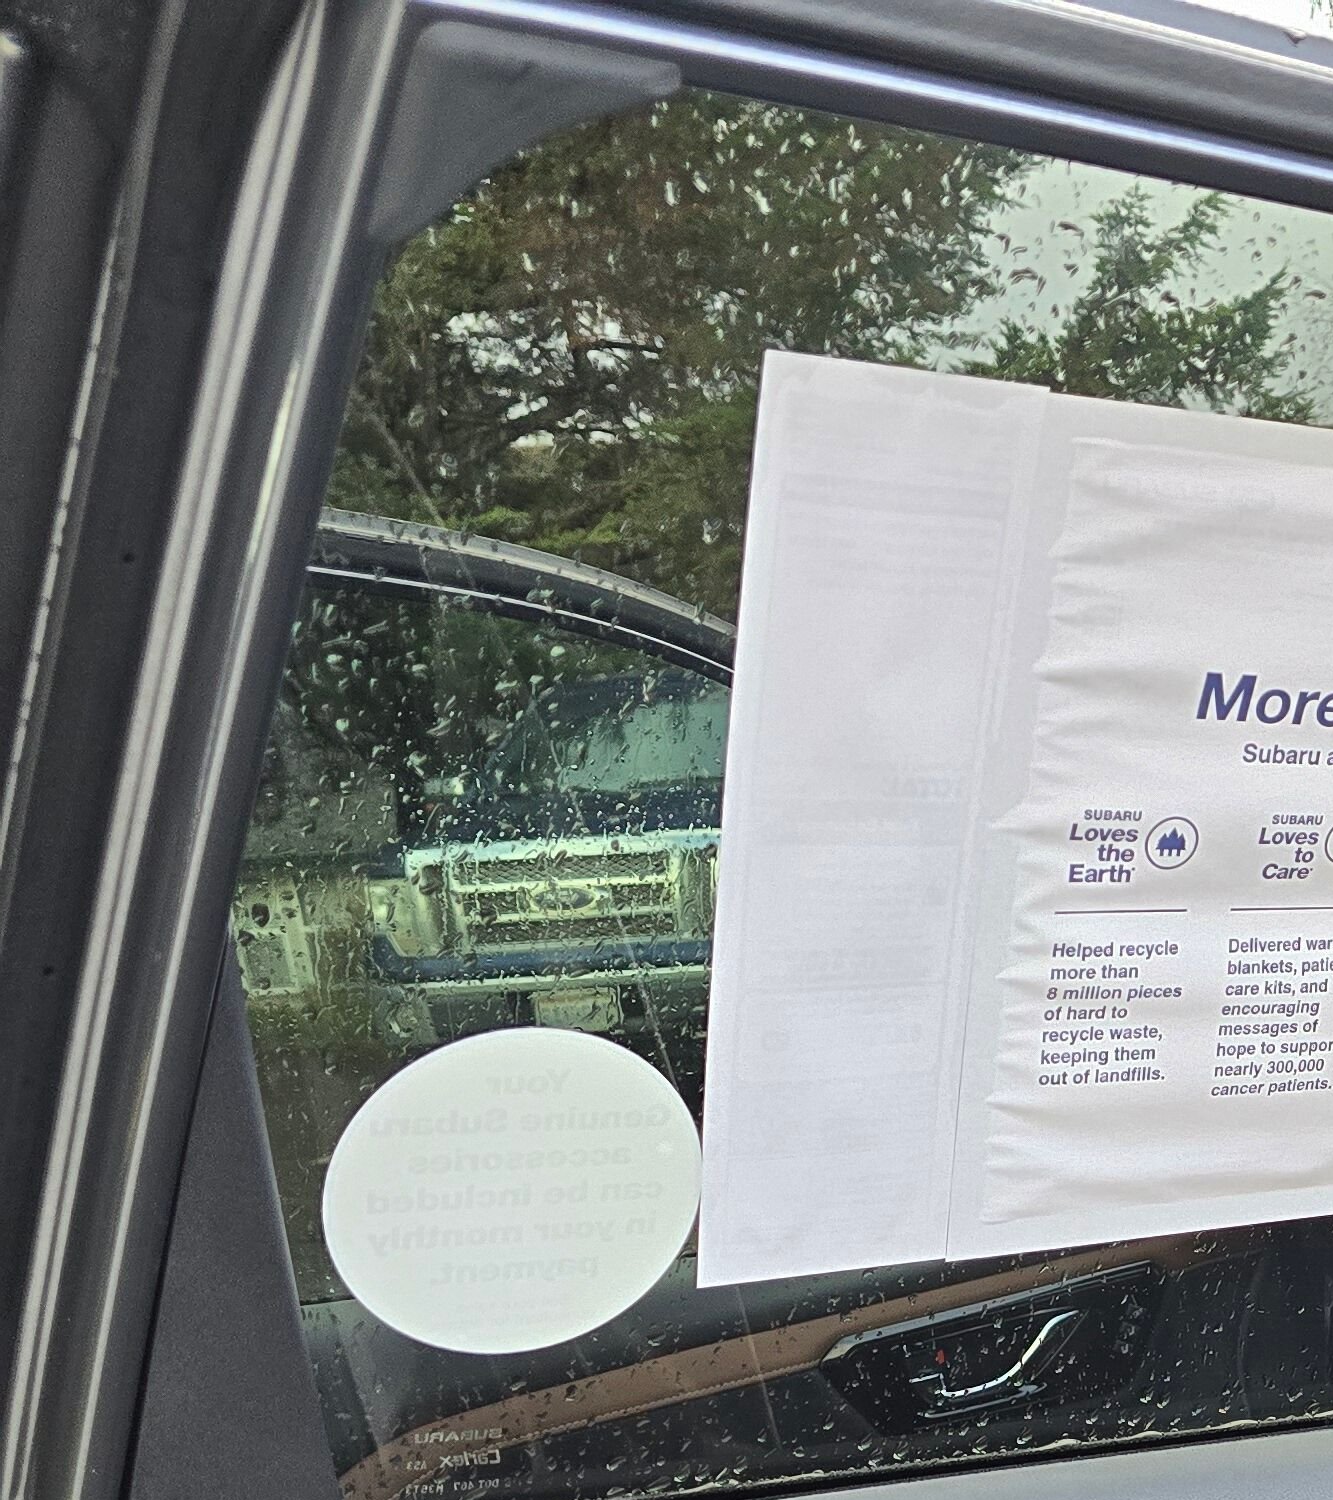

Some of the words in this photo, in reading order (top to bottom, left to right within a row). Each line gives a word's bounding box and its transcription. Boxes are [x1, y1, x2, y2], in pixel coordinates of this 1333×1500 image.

[1242, 742, 1322, 766] Subaru
[1083, 808, 1143, 822] SUBARU
[1271, 814, 1324, 826] SUBARU
[1068, 822, 1140, 843] Loves
[1258, 826, 1320, 846] Loves
[1096, 843, 1135, 863] the
[1294, 847, 1315, 864] to
[1052, 941, 1114, 962] Helped
[1118, 939, 1179, 961] recycle
[1228, 936, 1302, 954] Delivered
[1050, 967, 1097, 981] more
[1101, 963, 1139, 980] than
[1227, 959, 1298, 976] blankets,
[1046, 986, 1059, 1001] 8
[1062, 985, 1123, 1001] million
[1126, 984, 1183, 1003] pieces
[1224, 984, 1260, 997] care
[1263, 979, 1296, 997] kits,
[1299, 978, 1329, 994] and
[1043, 1005, 1063, 1022] of
[1066, 1005, 1107, 1021] hard
[1111, 1005, 1128, 1019] to
[1221, 999, 1321, 1018] encouraging
[1041, 1025, 1105, 1046] recycle
[1109, 1024, 1163, 1042] waste,
[1218, 1022, 1299, 1038] messages
[1302, 1018, 1320, 1033] of
[1040, 1047, 1109, 1068] keeping
[1114, 1046, 1156, 1062] them
[1216, 1042, 1257, 1060] hope
[1260, 1041, 1276, 1055] to
[1038, 1071, 1069, 1086] out
[1072, 1068, 1091, 1085] of
[1094, 1066, 1165, 1084] landfills.
[1214, 1061, 1264, 1079] nearly
[1266, 1058, 1325, 1076] 300,000
[1210, 1083, 1265, 1097] cancer
[1267, 1077, 1332, 1097] patients.
